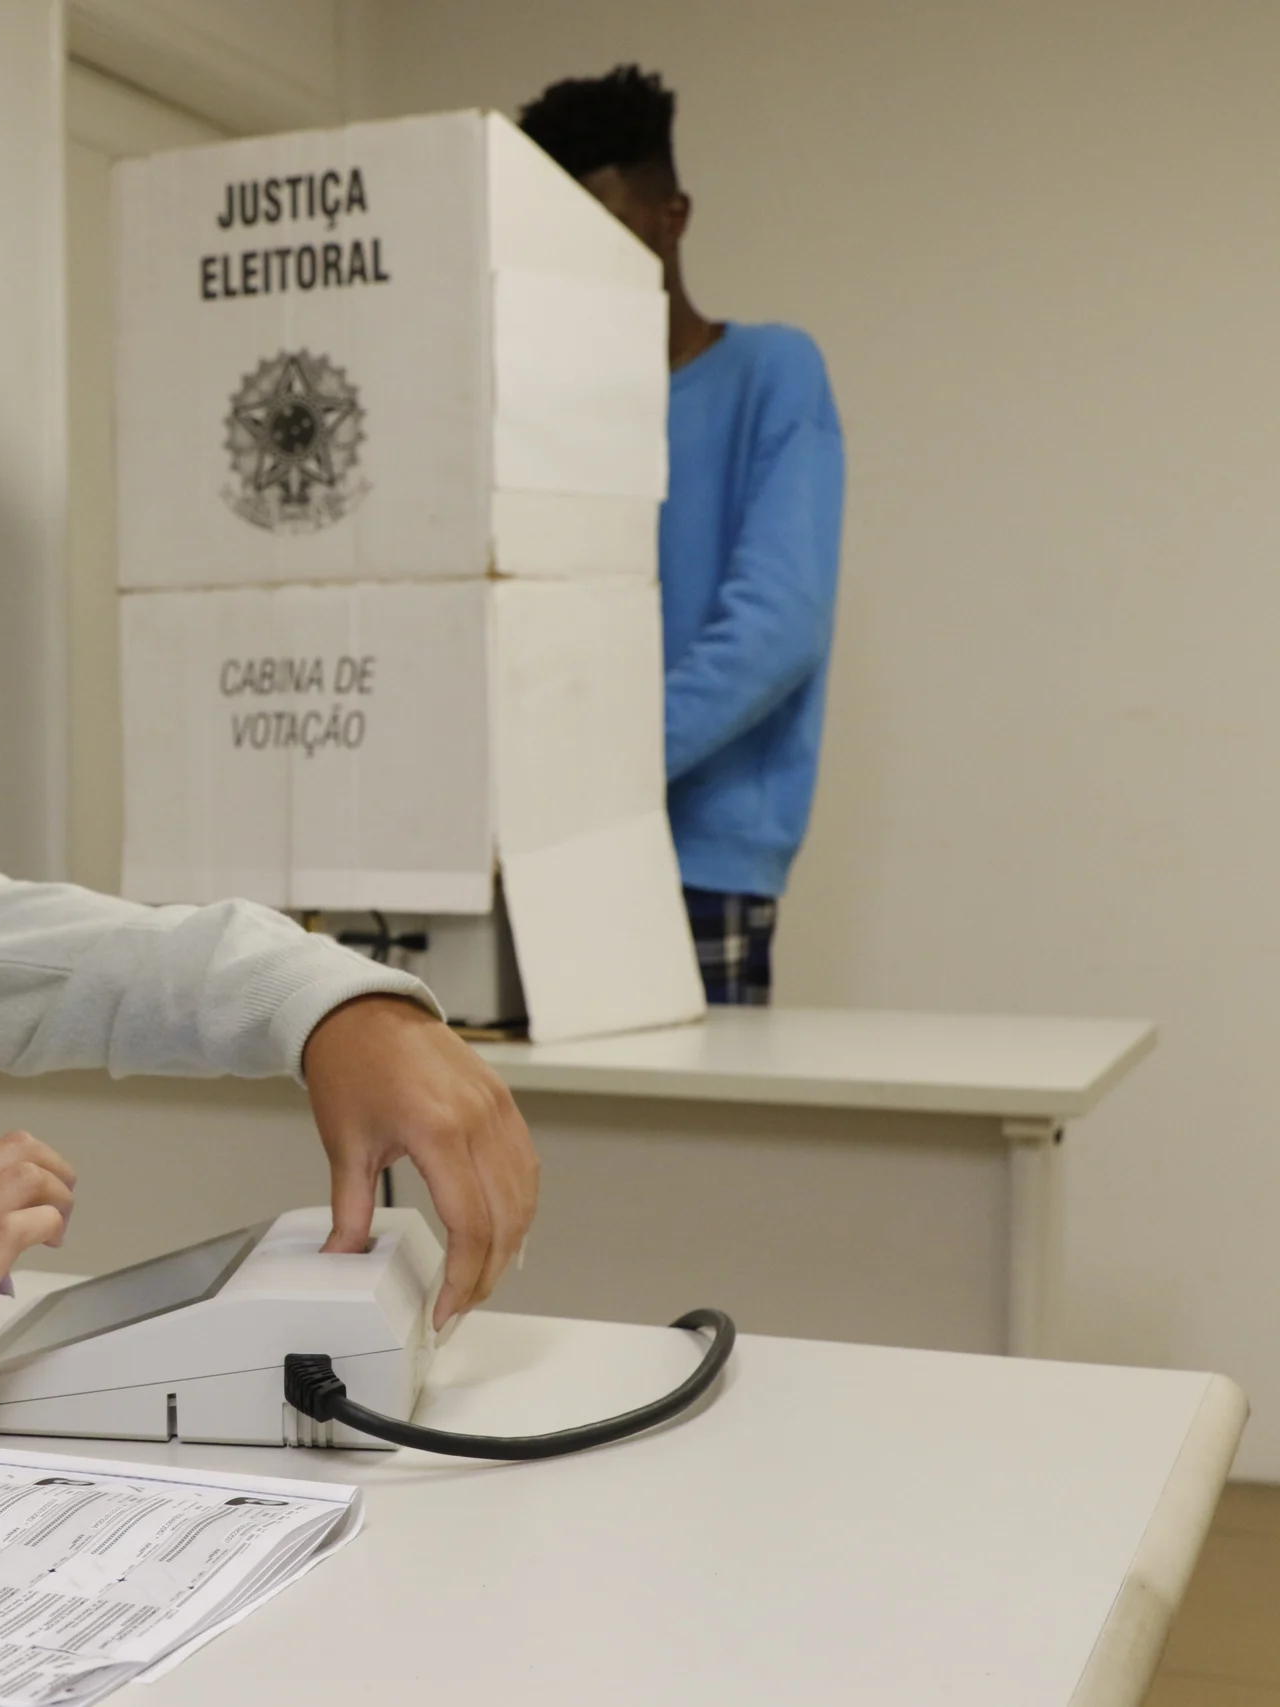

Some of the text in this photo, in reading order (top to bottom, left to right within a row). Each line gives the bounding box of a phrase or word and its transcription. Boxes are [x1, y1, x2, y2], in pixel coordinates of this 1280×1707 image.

[217, 167, 367, 231] JUSTIÇA
[200, 237, 390, 301] ELEITORAL
[219, 656, 375, 697] CABINA DE
[231, 703, 365, 760] VOTAÇÃO
